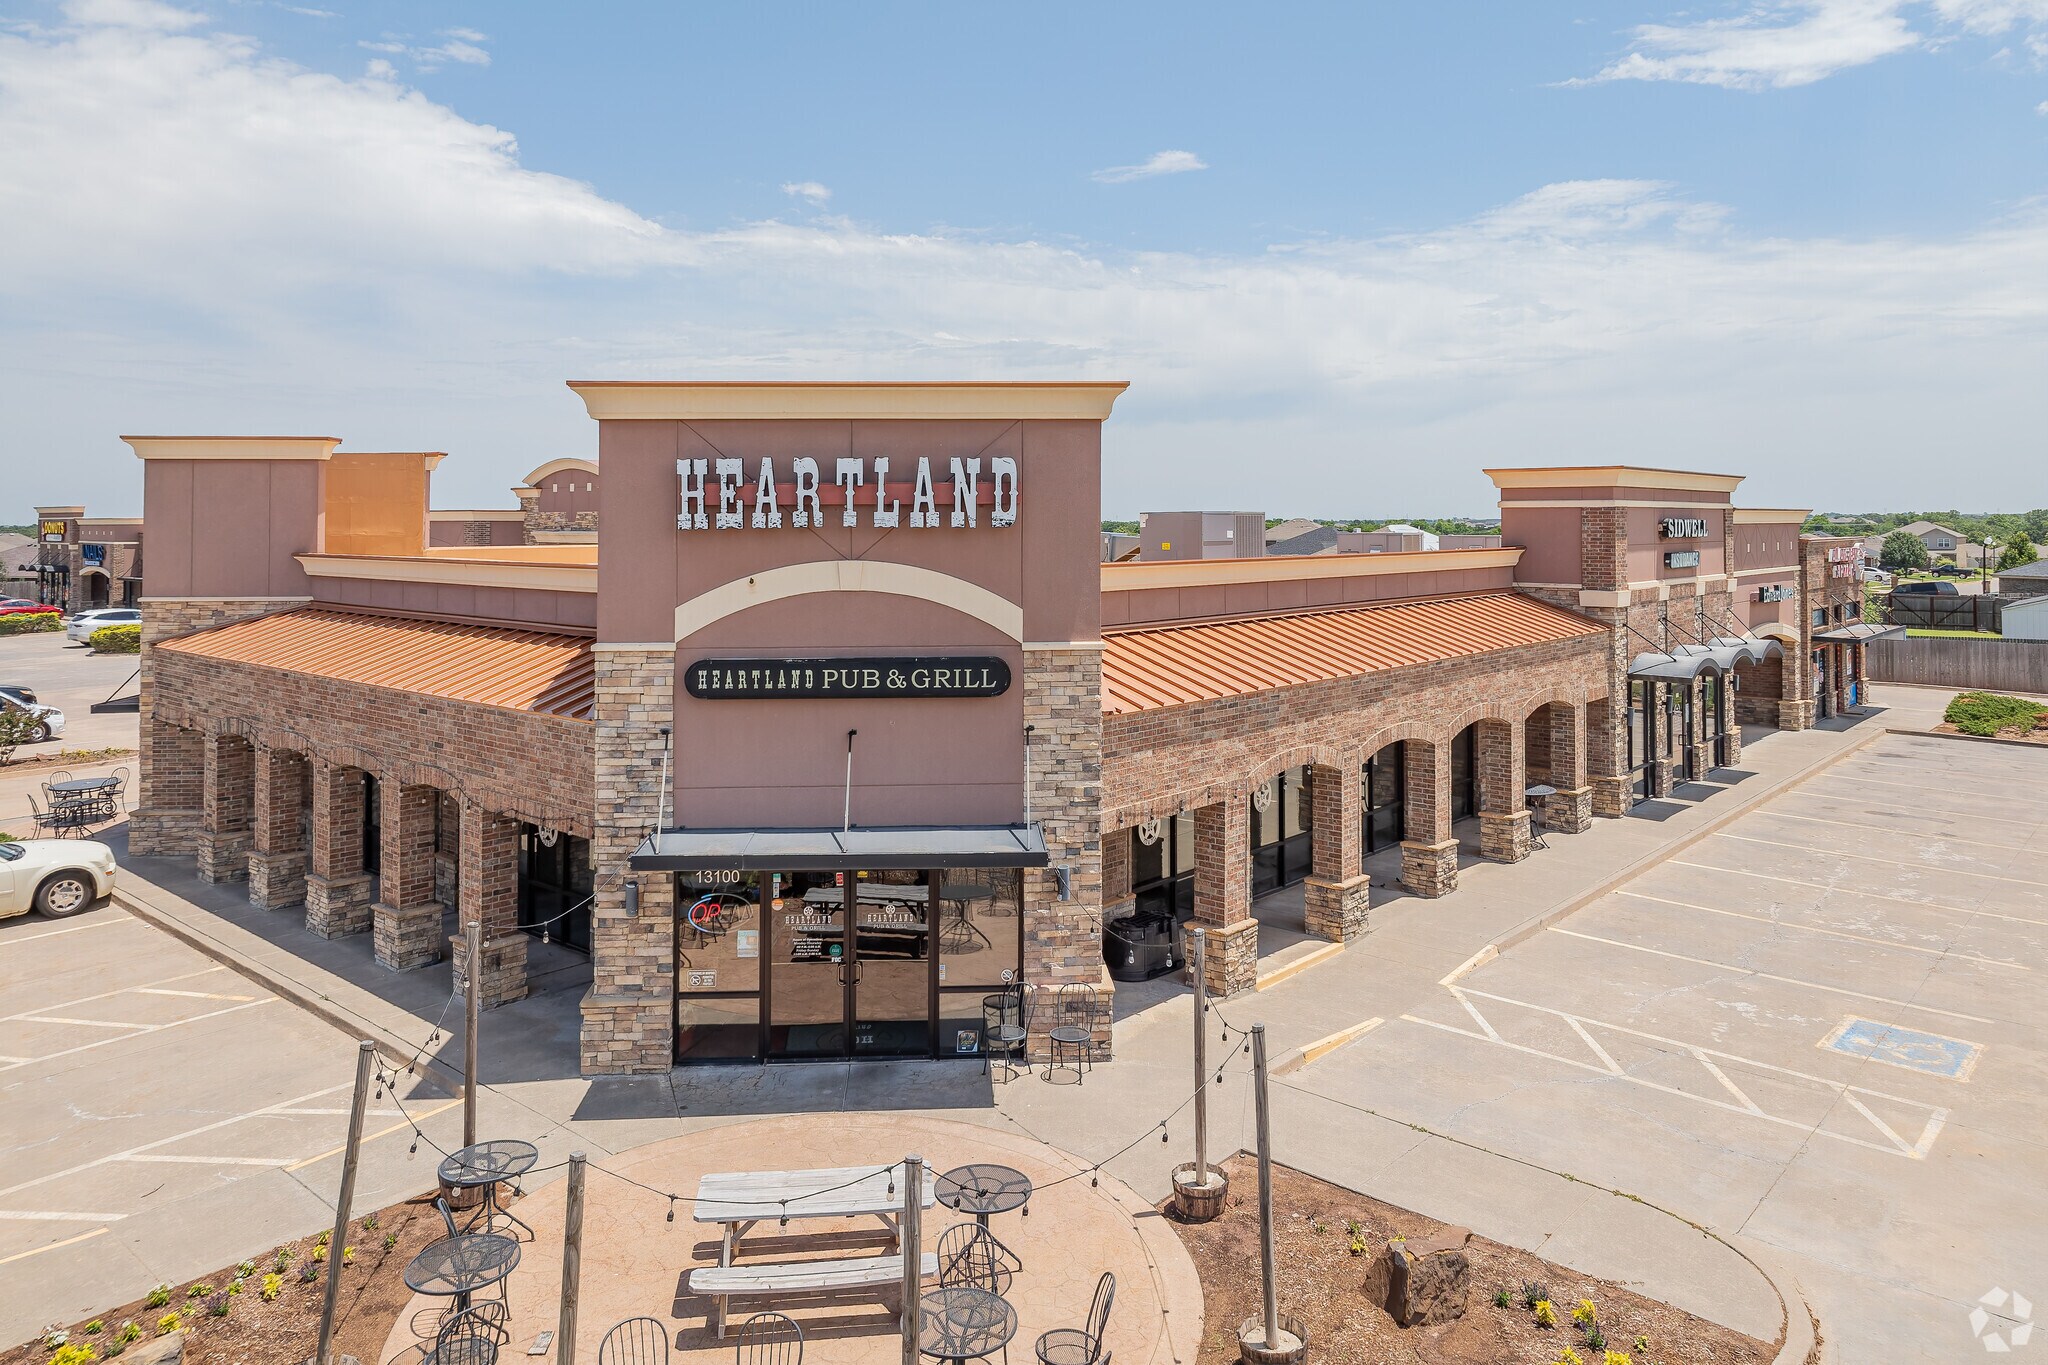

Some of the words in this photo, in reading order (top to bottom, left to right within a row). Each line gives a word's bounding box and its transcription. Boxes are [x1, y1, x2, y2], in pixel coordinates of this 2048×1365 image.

[676, 456, 1020, 530] HEARTLAND
[44, 521, 65, 534] DONUTS
[1667, 518, 1709, 538] SIDWELL
[697, 669, 814, 690] HEARTLAND
[696, 869, 740, 884] 13100
[692, 903, 753, 924] OPEN
[785, 915, 832, 924] HEARTLAND
[868, 913, 914, 922] HEARTLAND
